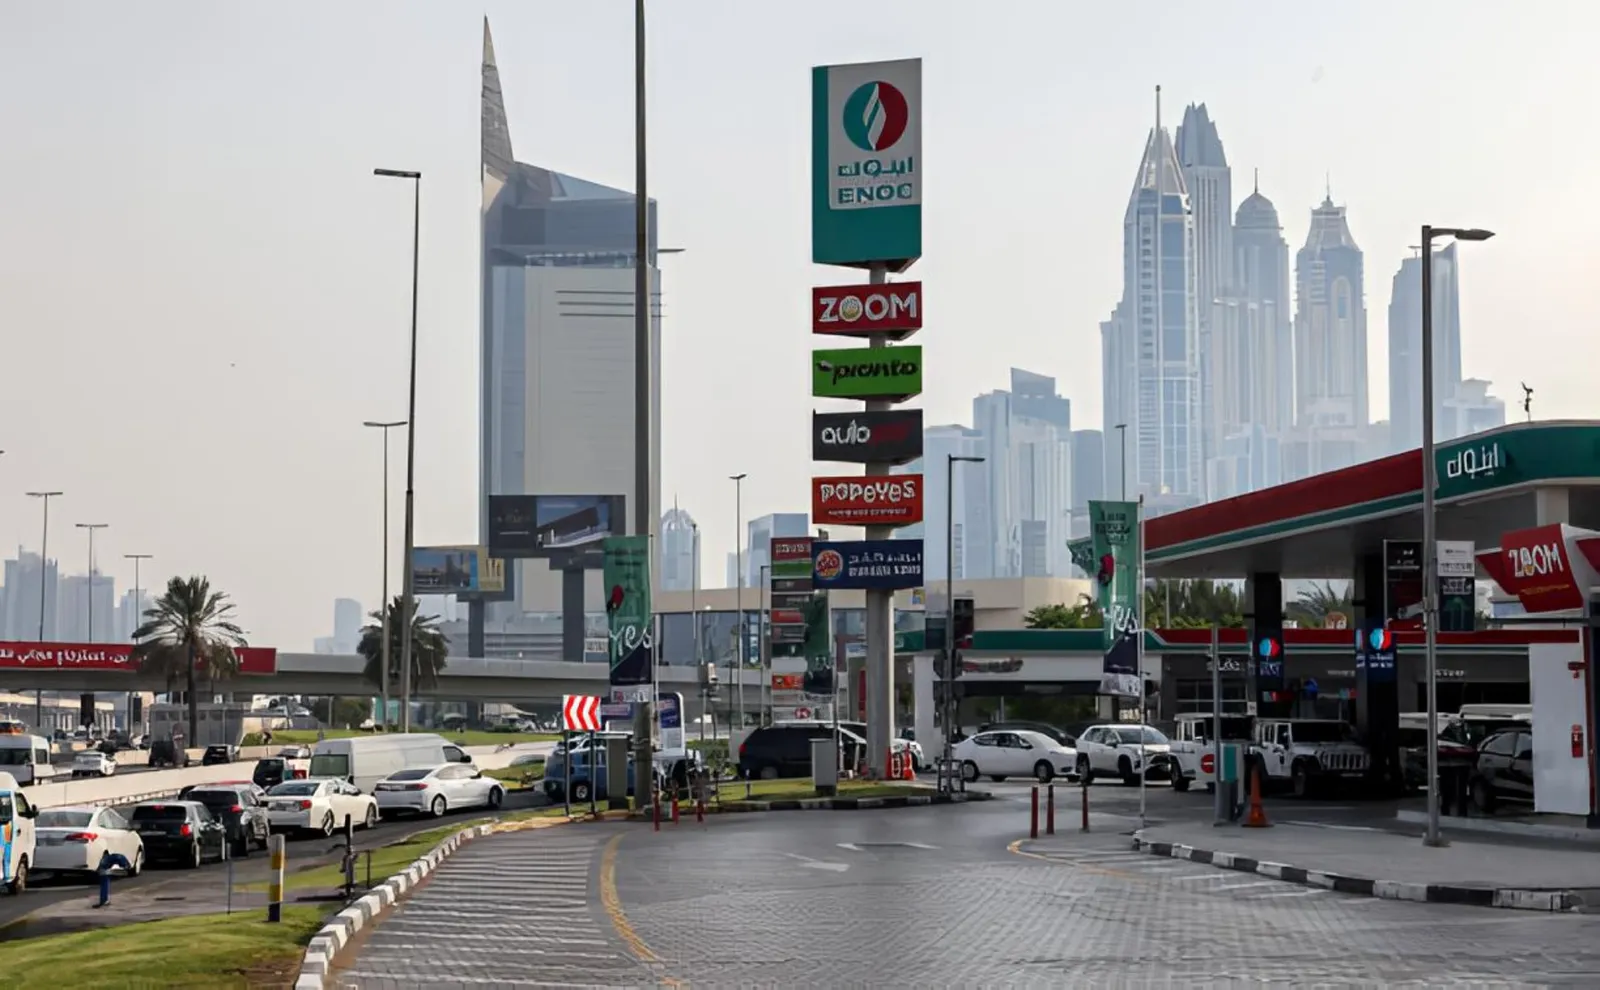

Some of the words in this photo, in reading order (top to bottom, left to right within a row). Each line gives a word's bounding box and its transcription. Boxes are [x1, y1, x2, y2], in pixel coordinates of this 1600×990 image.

[838, 183, 912, 203] ENOC
[819, 293, 917, 322] ZOOM
[1508, 542, 1564, 578] ZOOM
